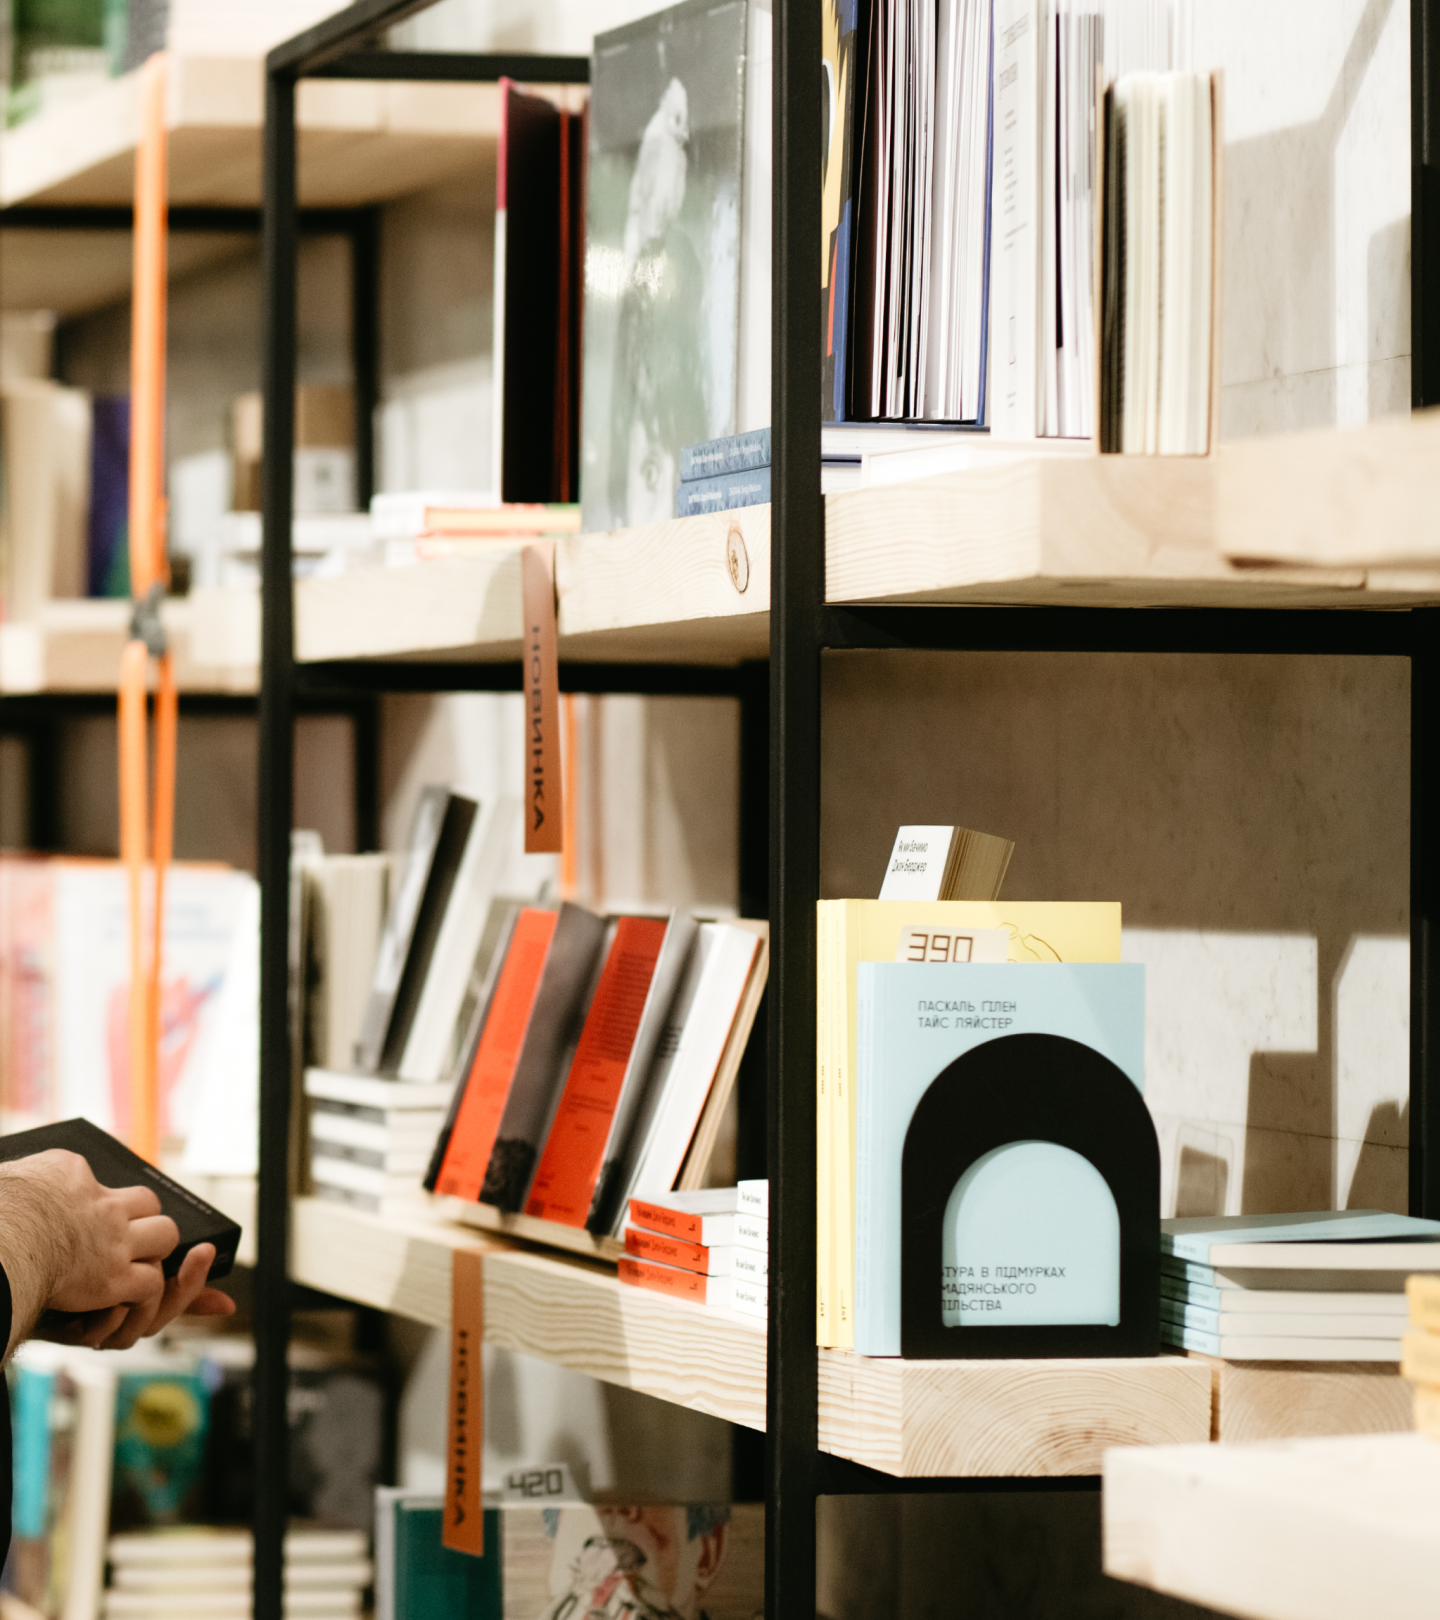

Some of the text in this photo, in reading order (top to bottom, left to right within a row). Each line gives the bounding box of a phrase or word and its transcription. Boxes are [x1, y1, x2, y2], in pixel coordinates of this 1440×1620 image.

[531, 625, 545, 832] НОВИНКА
[907, 933, 974, 962] 390
[918, 1000, 976, 1012] ПАСКАЛЬ
[918, 1015, 1014, 1029] ТАЙС ЛЯЙСТЕР
[981, 1266, 990, 1278] В
[995, 1266, 1067, 1279] ПІДМУРКАХ
[454, 1330, 468, 1527] НОВИНКА
[507, 1469, 564, 1498] 420
